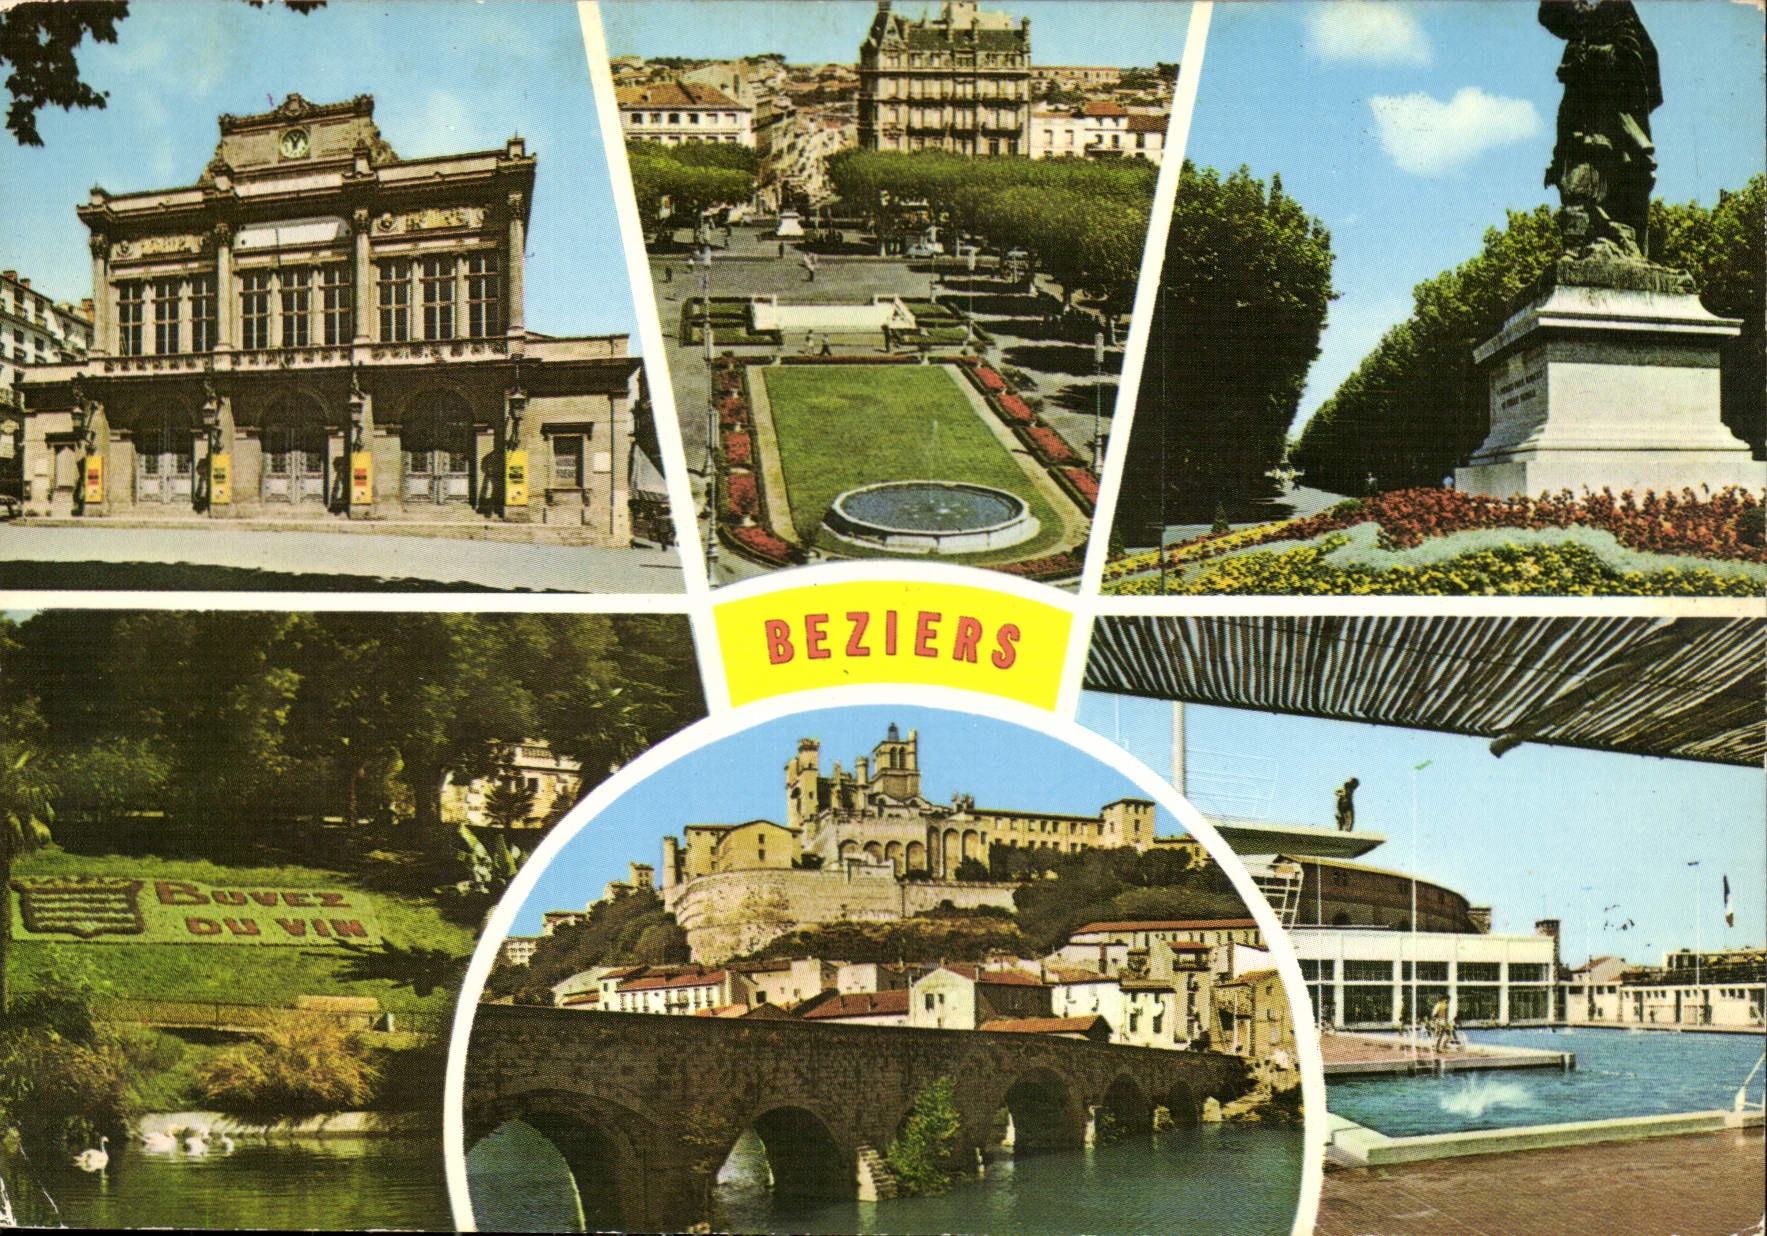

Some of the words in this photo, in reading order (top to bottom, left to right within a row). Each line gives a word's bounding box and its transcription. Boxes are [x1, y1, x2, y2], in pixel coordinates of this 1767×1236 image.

[153, 880, 352, 907] BUVEZ
[185, 917, 261, 936] DU
[274, 917, 369, 938] VIN
